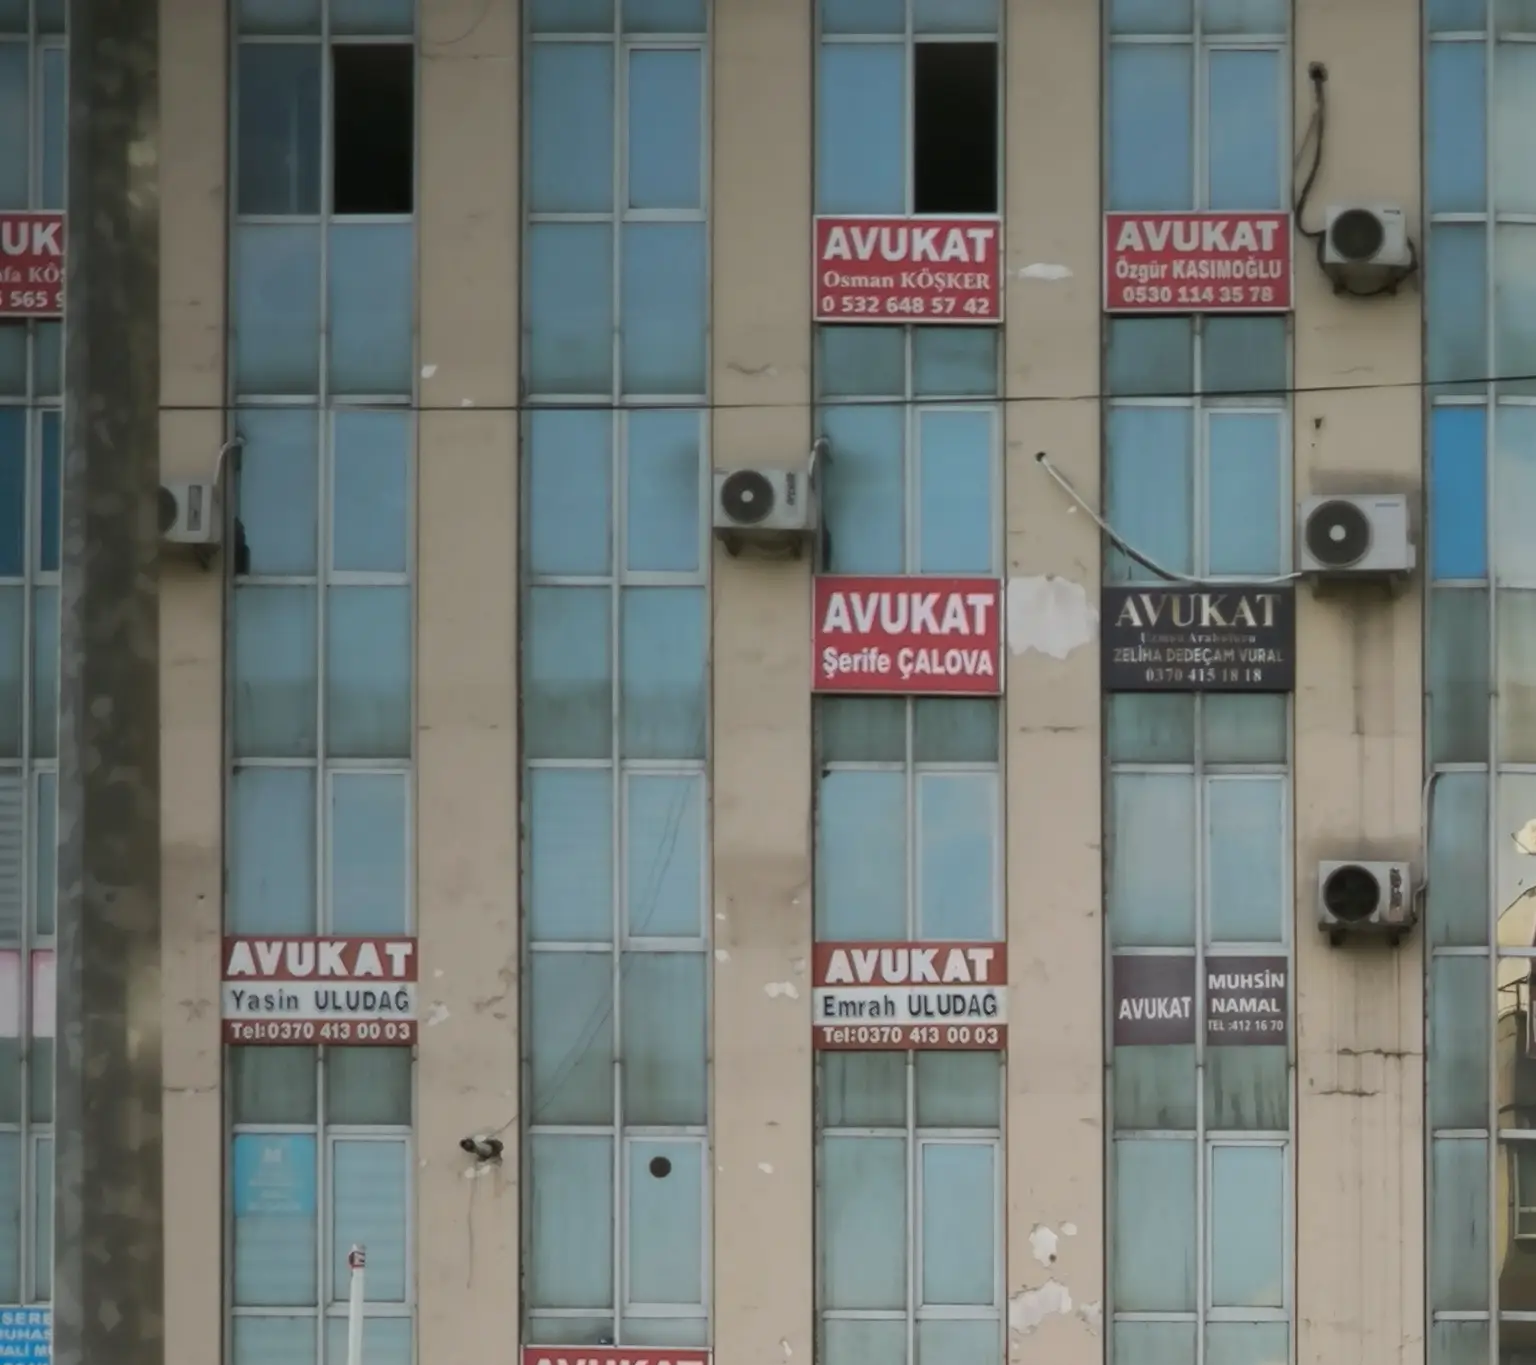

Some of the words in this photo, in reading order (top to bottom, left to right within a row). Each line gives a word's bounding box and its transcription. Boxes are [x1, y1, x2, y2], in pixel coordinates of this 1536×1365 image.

[823, 227, 995, 262] AVUKAT
[1115, 220, 1280, 252] AVUKAT
[823, 269, 895, 288] Osman
[901, 266, 991, 292] KÖŞKER
[1115, 258, 1168, 283] Özgür
[1172, 256, 1282, 281] KASIMOĞLU
[10, 294, 47, 313] 565
[824, 297, 833, 313] 0
[843, 296, 879, 314] 532
[887, 297, 924, 315] 648
[931, 297, 956, 315] 57
[964, 297, 992, 315] 42
[1123, 286, 1171, 304] 0530
[1178, 287, 1213, 304] 114
[1219, 287, 1244, 303] 35
[1249, 287, 1273, 303] 78
[823, 592, 995, 635] AVUKAT
[1115, 593, 1282, 627] AVUKAT
[823, 646, 891, 679] Şerife
[900, 648, 995, 680] ÇALOVA
[1113, 644, 1162, 662] ZELİHA
[1166, 647, 1235, 666] DEDEÇAM
[1239, 648, 1284, 662] VURAL
[1145, 667, 1182, 682] 0370
[1188, 668, 1215, 682] 415
[1245, 668, 1262, 682] 18
[227, 941, 414, 977] AVUKAT
[825, 948, 995, 983] AVUKAT
[1208, 969, 1285, 990] MUHSİN
[231, 988, 300, 1012] Yasin
[315, 985, 410, 1012] ULUDAĞ
[823, 993, 896, 1019] Emrah
[908, 988, 997, 1018] ULUDAĞ
[1119, 997, 1192, 1020] AVUKAT
[1211, 998, 1281, 1014] NAMAL
[321, 1023, 352, 1040] 413
[358, 1024, 380, 1040] 00
[385, 1024, 411, 1040] 03
[910, 1028, 940, 1045] 413
[948, 1029, 970, 1045] 00
[975, 1029, 999, 1045] 03
[1208, 1021, 1225, 1033] TEL
[1255, 1020, 1267, 1032] 16
[1270, 1020, 1284, 1032] 70
